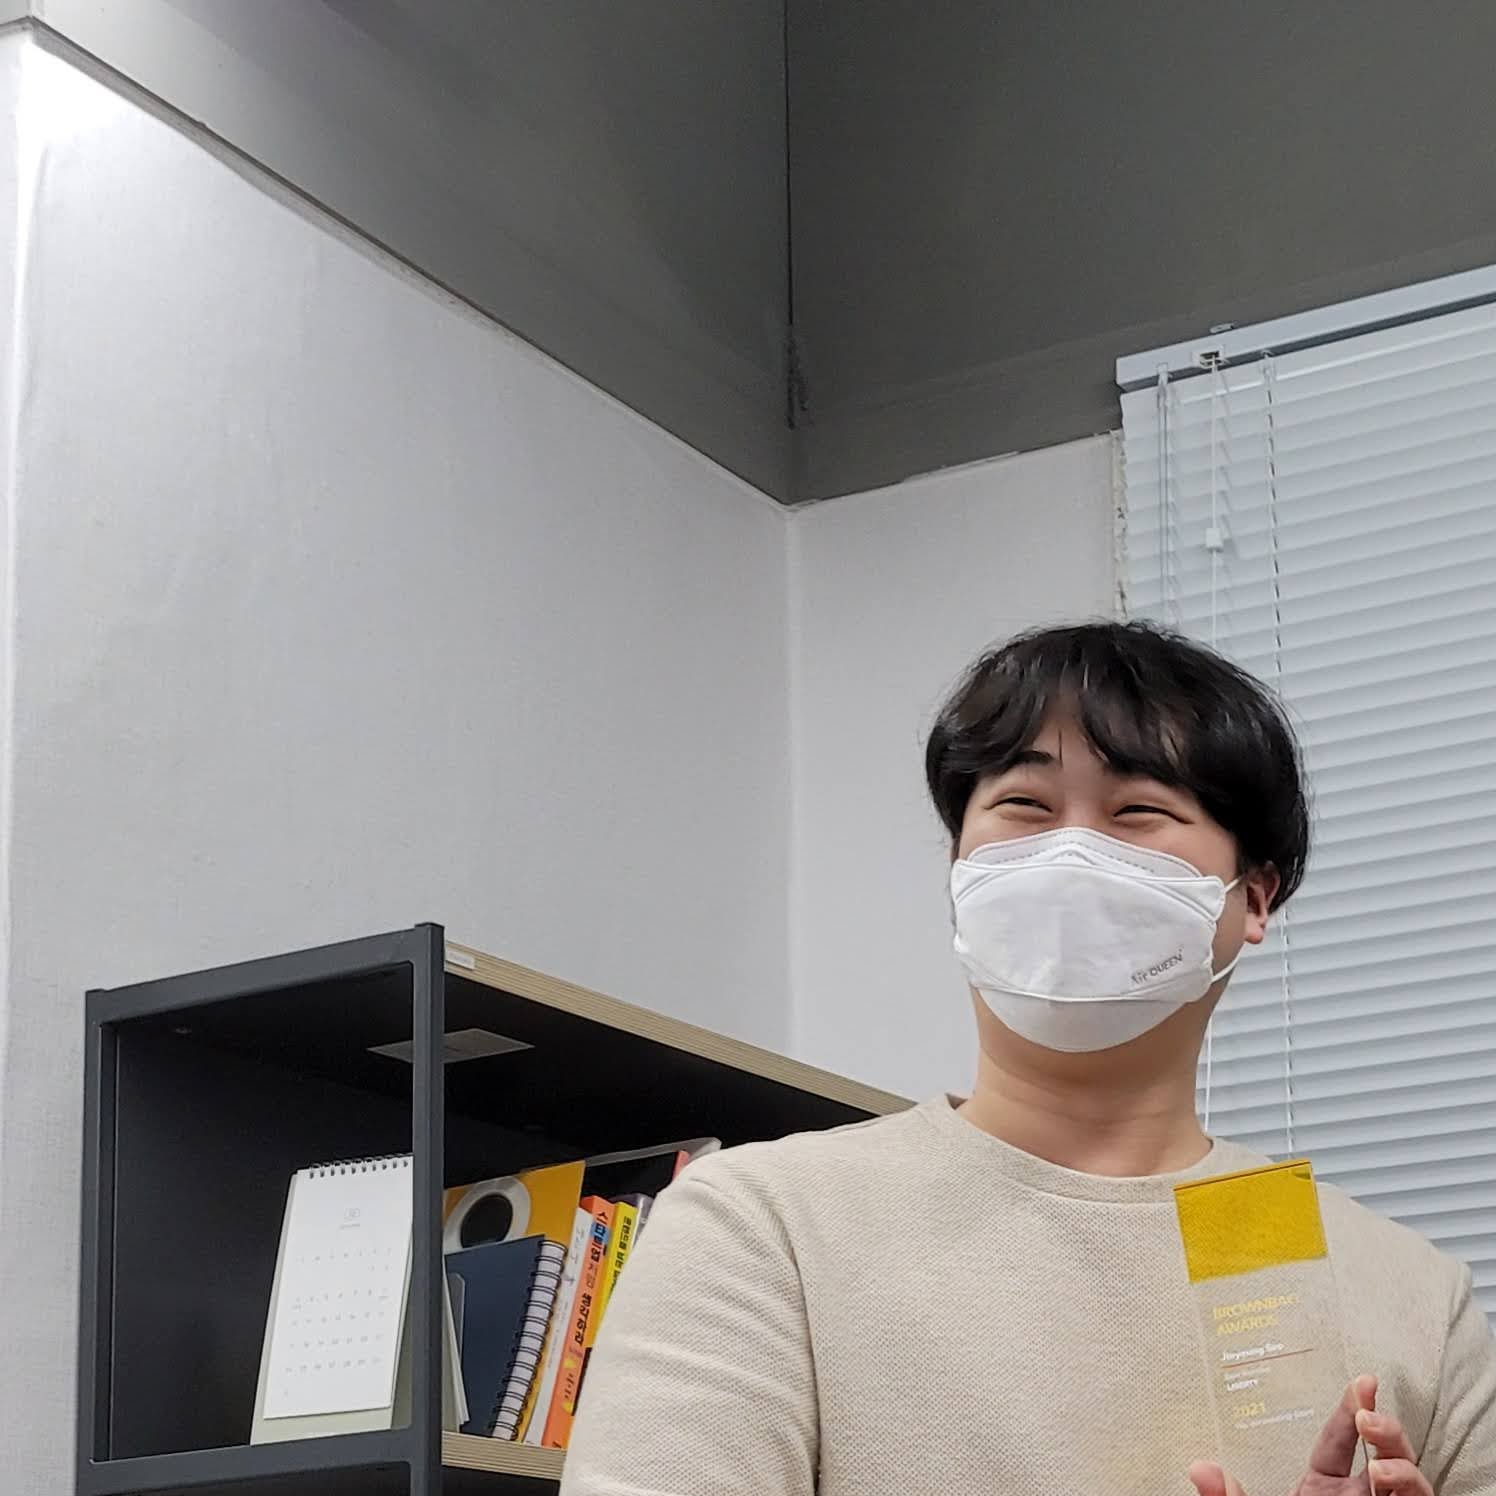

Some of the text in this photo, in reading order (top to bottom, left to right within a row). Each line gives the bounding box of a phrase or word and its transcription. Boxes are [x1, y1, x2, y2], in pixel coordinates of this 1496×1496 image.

[1150, 955, 1183, 977] QUEEN
[1213, 1295, 1298, 1319] BROWNBAG
[1216, 1314, 1279, 1336] AWARDS
